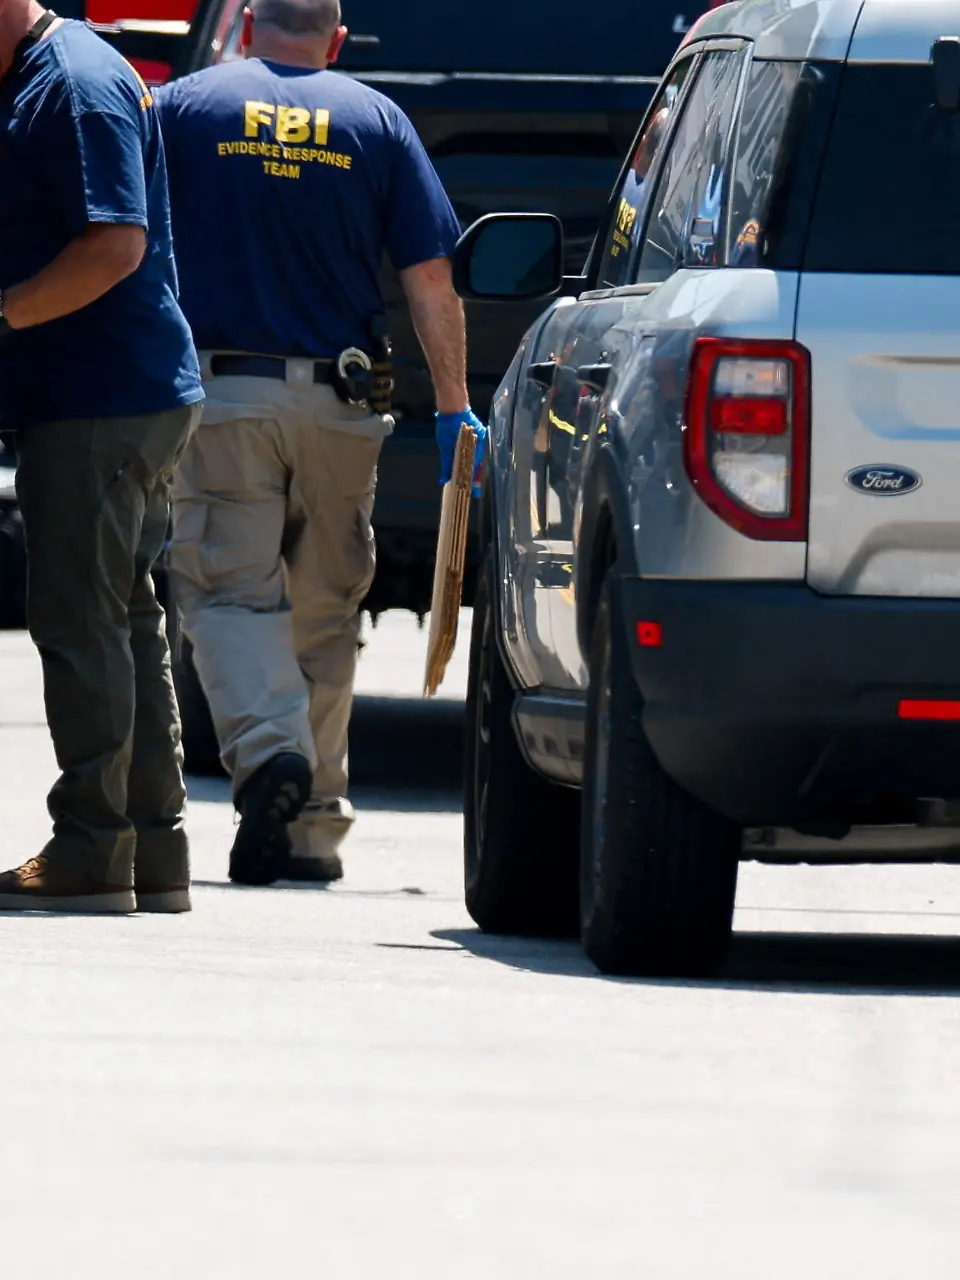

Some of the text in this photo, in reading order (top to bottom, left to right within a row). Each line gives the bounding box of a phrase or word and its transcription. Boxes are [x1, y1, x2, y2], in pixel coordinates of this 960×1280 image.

[244, 100, 330, 145] FBI
[217, 141, 353, 170] EVIDENCE RESPONSE
[263, 160, 300, 179] TEAM
[862, 471, 904, 488] Ford
